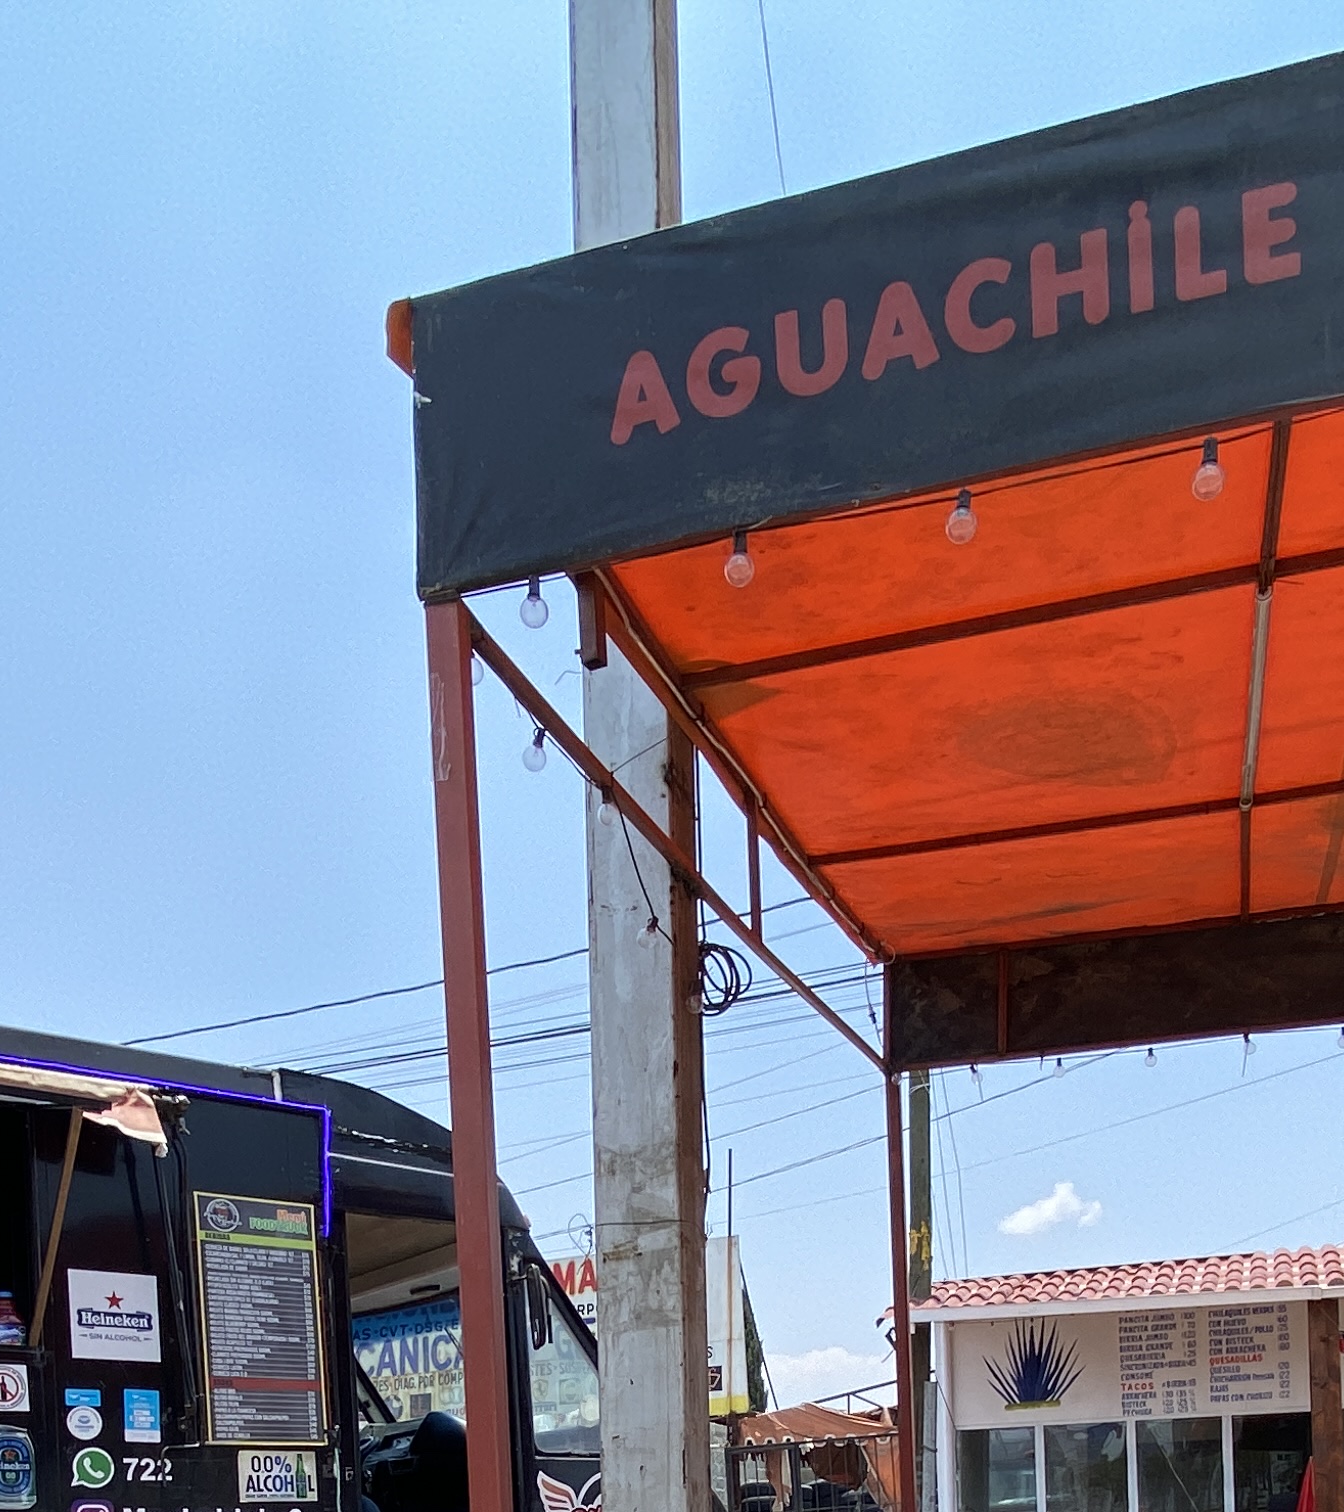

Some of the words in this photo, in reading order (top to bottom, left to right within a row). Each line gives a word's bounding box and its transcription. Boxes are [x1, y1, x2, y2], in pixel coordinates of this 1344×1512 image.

[553, 1258, 598, 1296] MA
[81, 1312, 149, 1328] Heineken
[104, 1333, 142, 1342] ALCOHOL
[355, 1335, 464, 1377] CANIC
[1209, 1353, 1264, 1366] QUESADILLAS
[438, 1372, 463, 1386] COMP
[1121, 1382, 1154, 1391] TACOS
[123, 1457, 173, 1482] 722
[251, 1455, 292, 1473] 0.0%
[246, 1474, 315, 1493] ALCOHL
